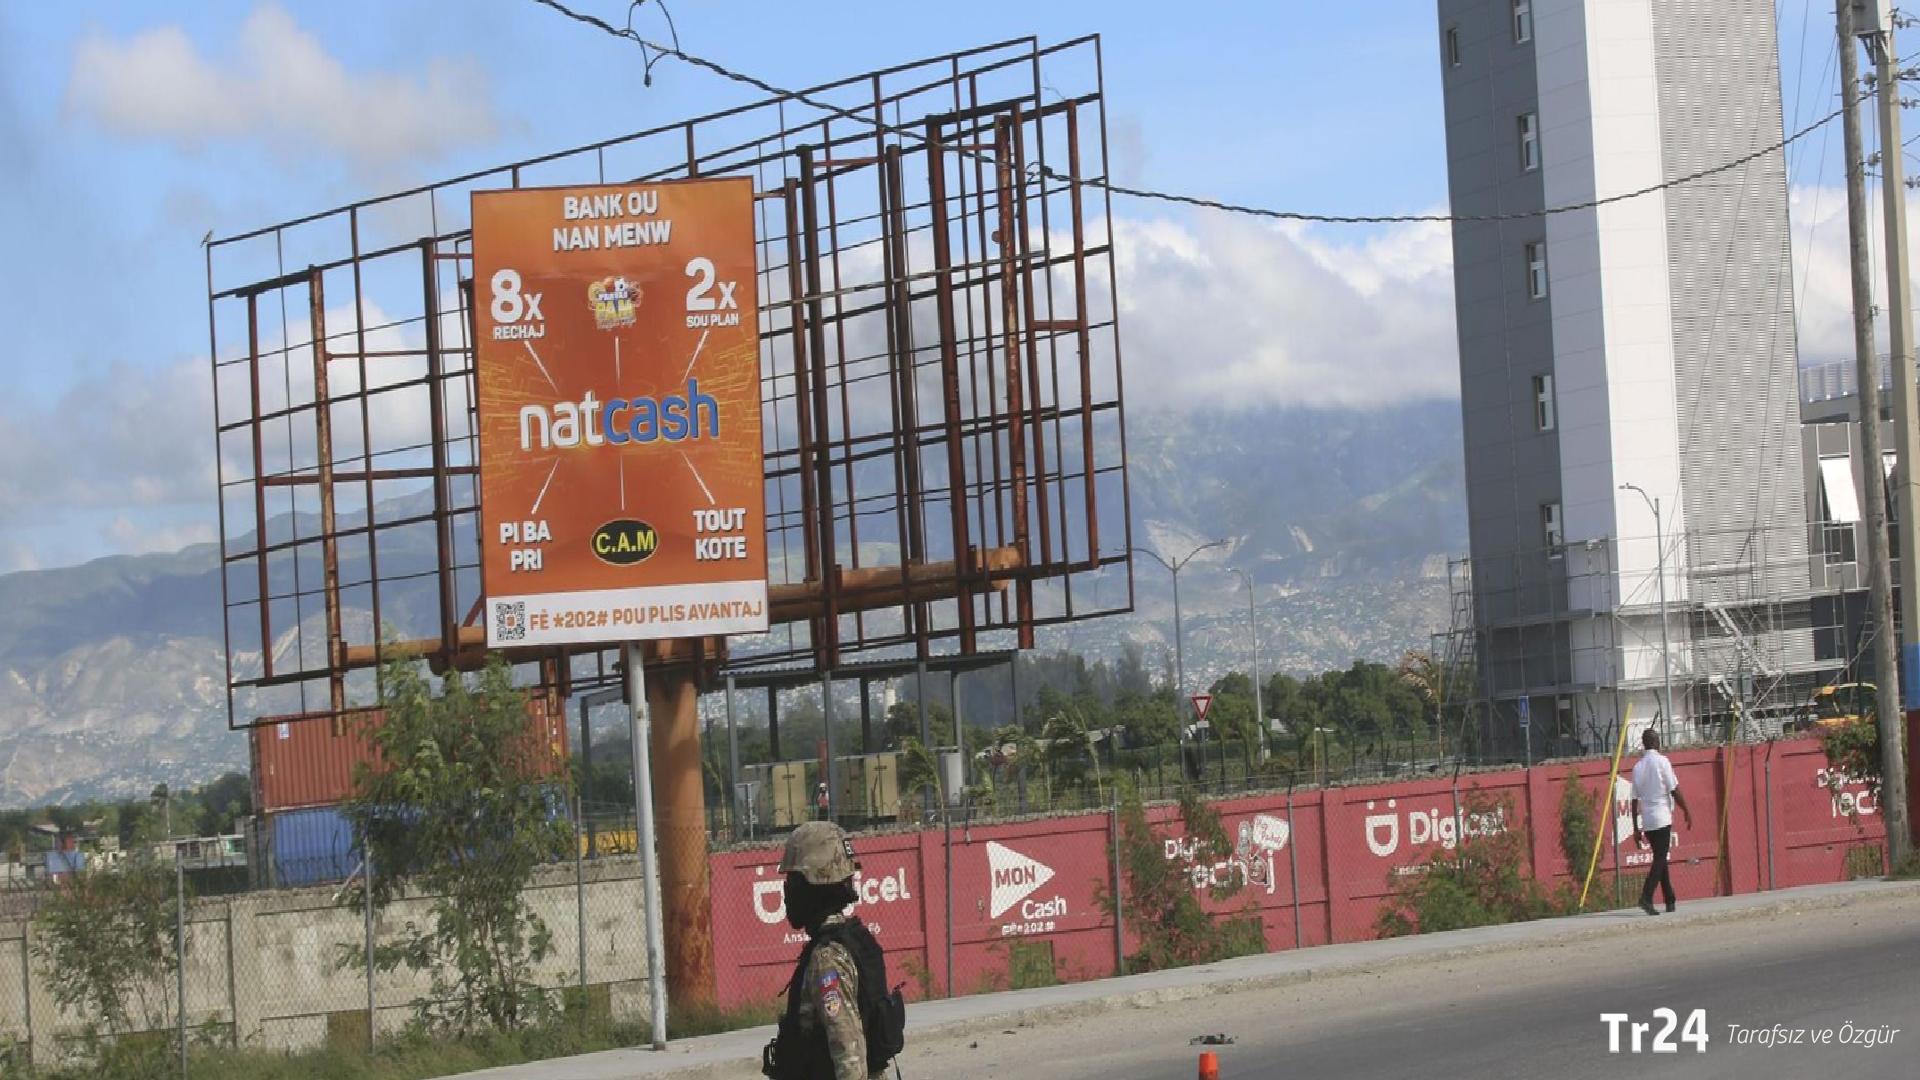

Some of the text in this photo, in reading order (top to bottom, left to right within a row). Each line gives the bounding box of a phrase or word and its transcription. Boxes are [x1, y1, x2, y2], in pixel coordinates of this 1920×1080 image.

[564, 191, 658, 220] BANK OU
[553, 221, 671, 251] NAN MENW
[490, 269, 543, 324] 8x
[685, 257, 737, 312] 2x
[493, 324, 544, 339] RECHAJ
[686, 313, 738, 328] SOU PLAN
[520, 377, 719, 451] natcash
[500, 520, 552, 544] PI BA
[693, 508, 746, 533] TOUT
[596, 529, 655, 554] C.A.M
[695, 536, 747, 560] KOTE
[511, 549, 542, 571] PRI
[613, 607, 645, 626] POU
[650, 604, 684, 623] PLIS
[688, 600, 762, 621] AVANTAJ
[994, 864, 1036, 889] MON
[1021, 895, 1067, 920] Cash
